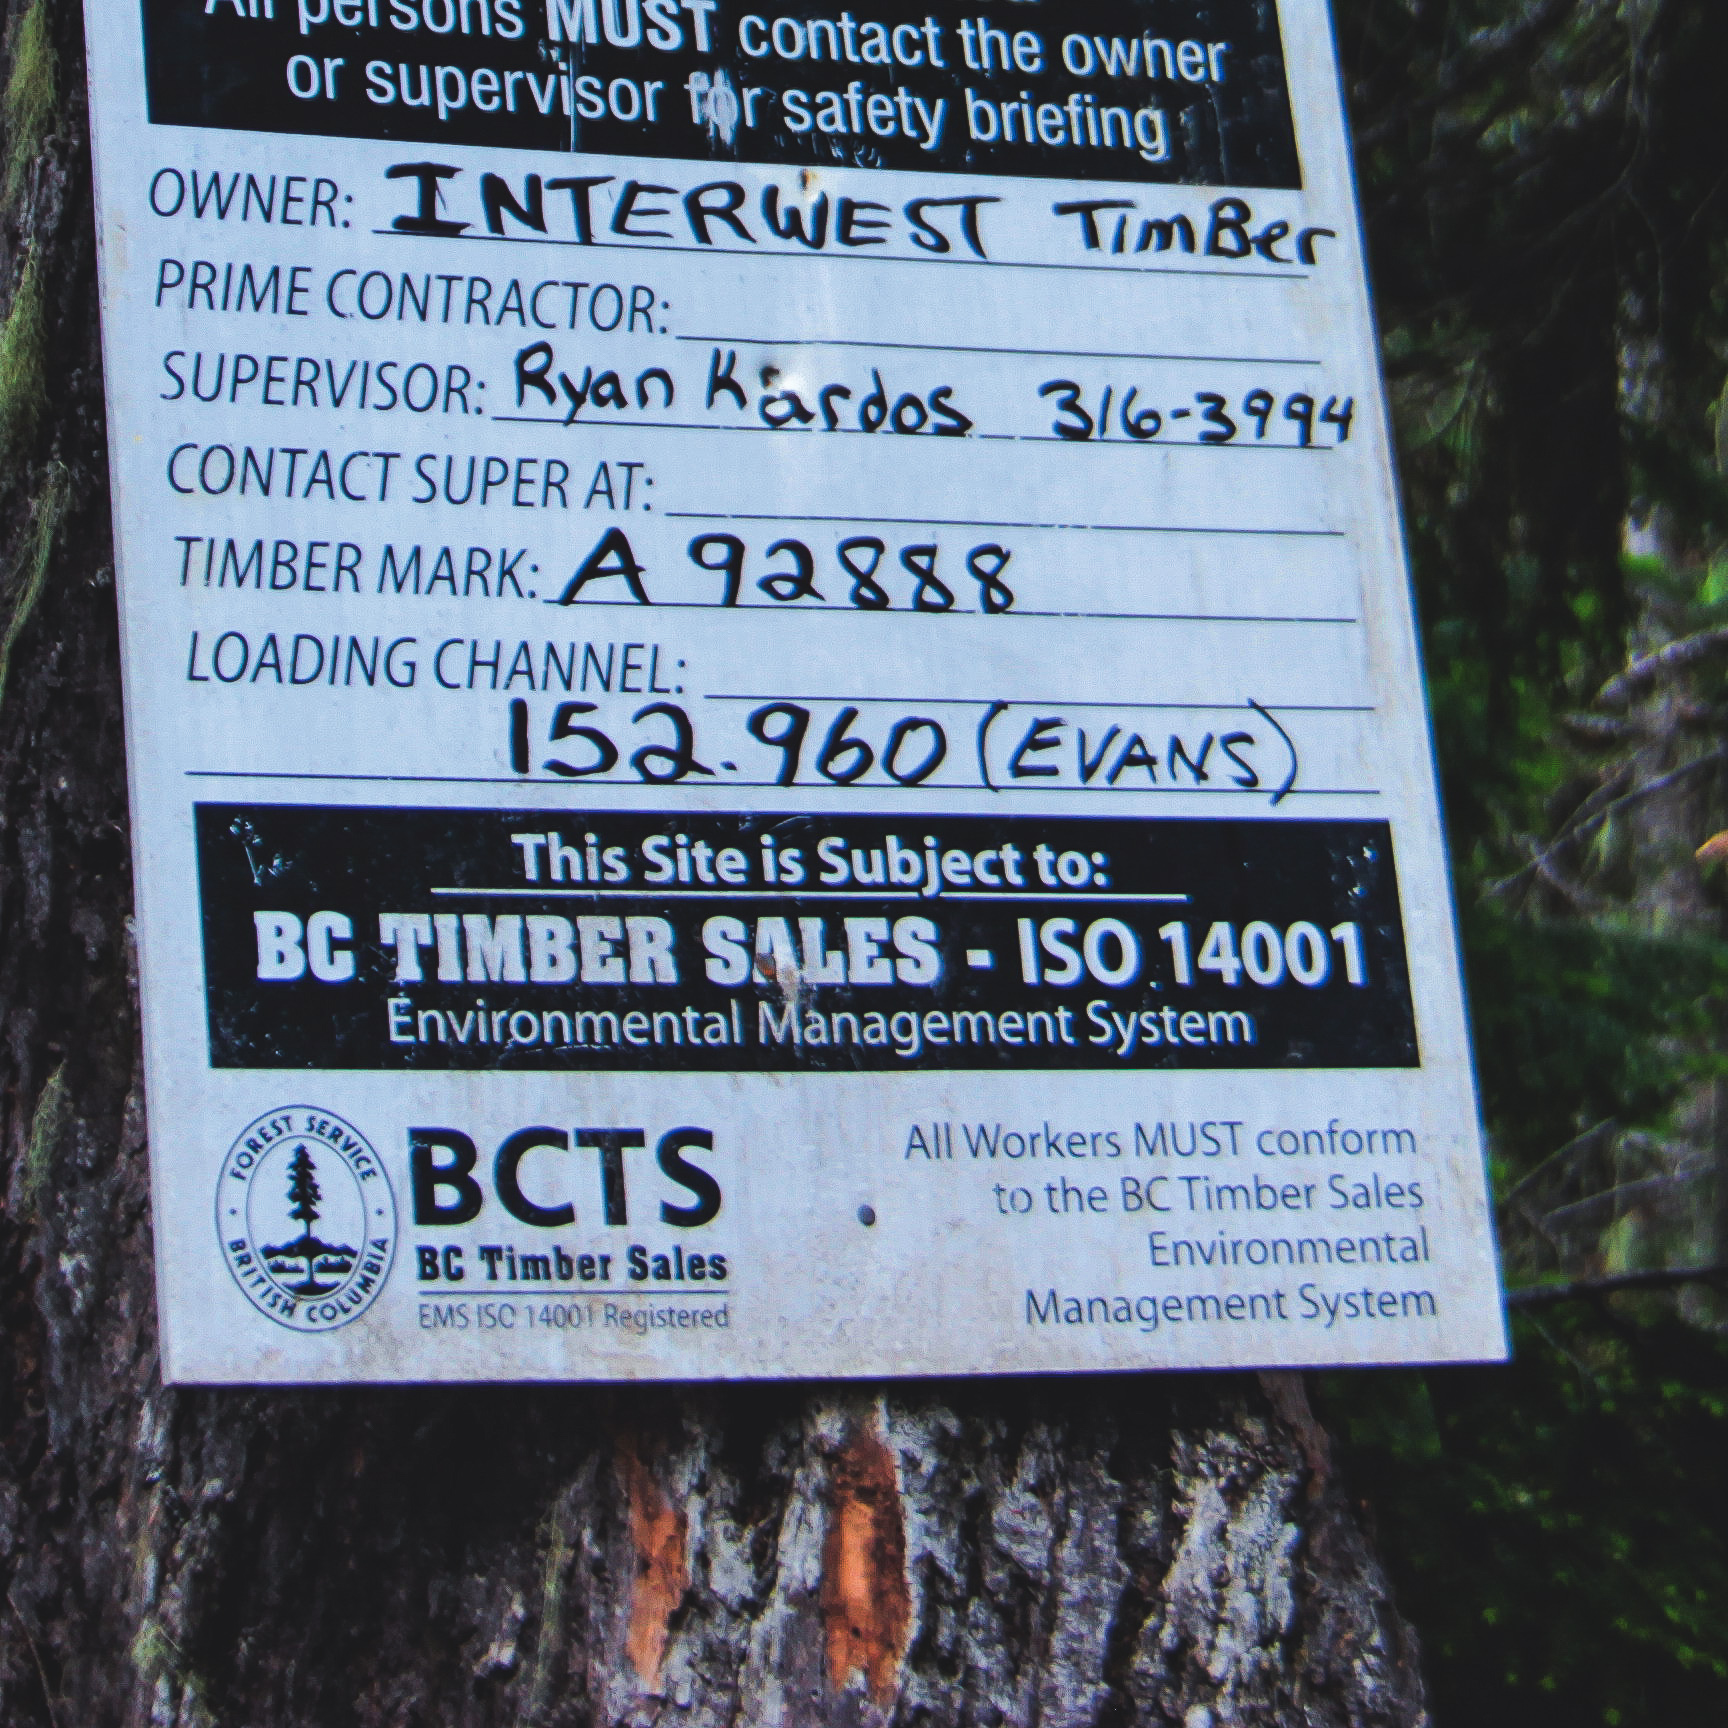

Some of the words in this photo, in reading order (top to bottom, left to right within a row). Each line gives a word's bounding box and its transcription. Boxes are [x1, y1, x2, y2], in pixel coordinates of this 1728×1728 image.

[738, 11, 945, 68] contact
[956, 18, 1042, 73] the
[1061, 34, 1229, 82] owner
[286, 54, 345, 101] or
[365, 60, 666, 122] supervisor
[683, 70, 762, 130] for
[782, 81, 948, 150] safety
[966, 88, 1170, 162] briefing
[149, 168, 354, 229] OWNER:
[384, 161, 1003, 260] INTERWEST
[154, 258, 313, 316] PRIME
[326, 268, 671, 334] CONTRACTOR:
[159, 350, 487, 416] SUPERVISOR:
[512, 340, 676, 426] Ryan
[1038, 379, 1355, 447] 316-3994
[167, 442, 402, 503] CONTACT
[412, 453, 570, 509] SUPER
[582, 460, 656, 513] AT:
[174, 535, 362, 594] TIMBER
[376, 544, 540, 600] MARK:
[557, 526, 652, 605] A
[686, 531, 1016, 617] 92888
[185, 630, 418, 689] LOADING
[432, 637, 688, 696] CHANNEL:
[974, 696, 1300, 809] (EVANS)
[510, 831, 630, 885] This
[642, 833, 749, 885] Site
[760, 833, 805, 885] is
[815, 834, 1025, 900] Subject
[1032, 842, 1109, 889] to:
[252, 909, 356, 983] BC
[377, 912, 680, 987] TIMBER
[700, 915, 942, 988] SALES
[965, 946, 995, 970] -
[1015, 916, 1141, 987] ISO
[1157, 920, 1370, 988] 14001
[386, 995, 744, 1048] Environmental
[756, 999, 1074, 1059] Management
[1084, 998, 1257, 1058] System
[229, 1114, 293, 1182] FOREST
[305, 1114, 378, 1182] SERVICE
[904, 1122, 953, 1159] All
[962, 1123, 1122, 1159] Workers
[1133, 1121, 1243, 1158] MUST
[1256, 1119, 1418, 1157] conform
[406, 1124, 722, 1229] BCTS
[991, 1181, 1033, 1214] to
[1044, 1176, 1108, 1213] the
[1119, 1176, 1172, 1212] BC
[1177, 1174, 1317, 1211] Timber
[1328, 1172, 1424, 1209] Sales
[227, 1236, 297, 1320] BRITISH
[304, 1236, 390, 1324] COLUMBIA
[415, 1245, 465, 1282] BC
[478, 1245, 612, 1283] Timber
[625, 1245, 729, 1282] Sales
[1148, 1226, 1431, 1266] Environmental
[418, 1303, 469, 1330] EMS
[477, 1303, 515, 1329] ISO
[525, 1303, 594, 1330] 14001
[604, 1302, 731, 1335] Registered
[1024, 1285, 1288, 1332] Management
[1299, 1283, 1438, 1328] System
